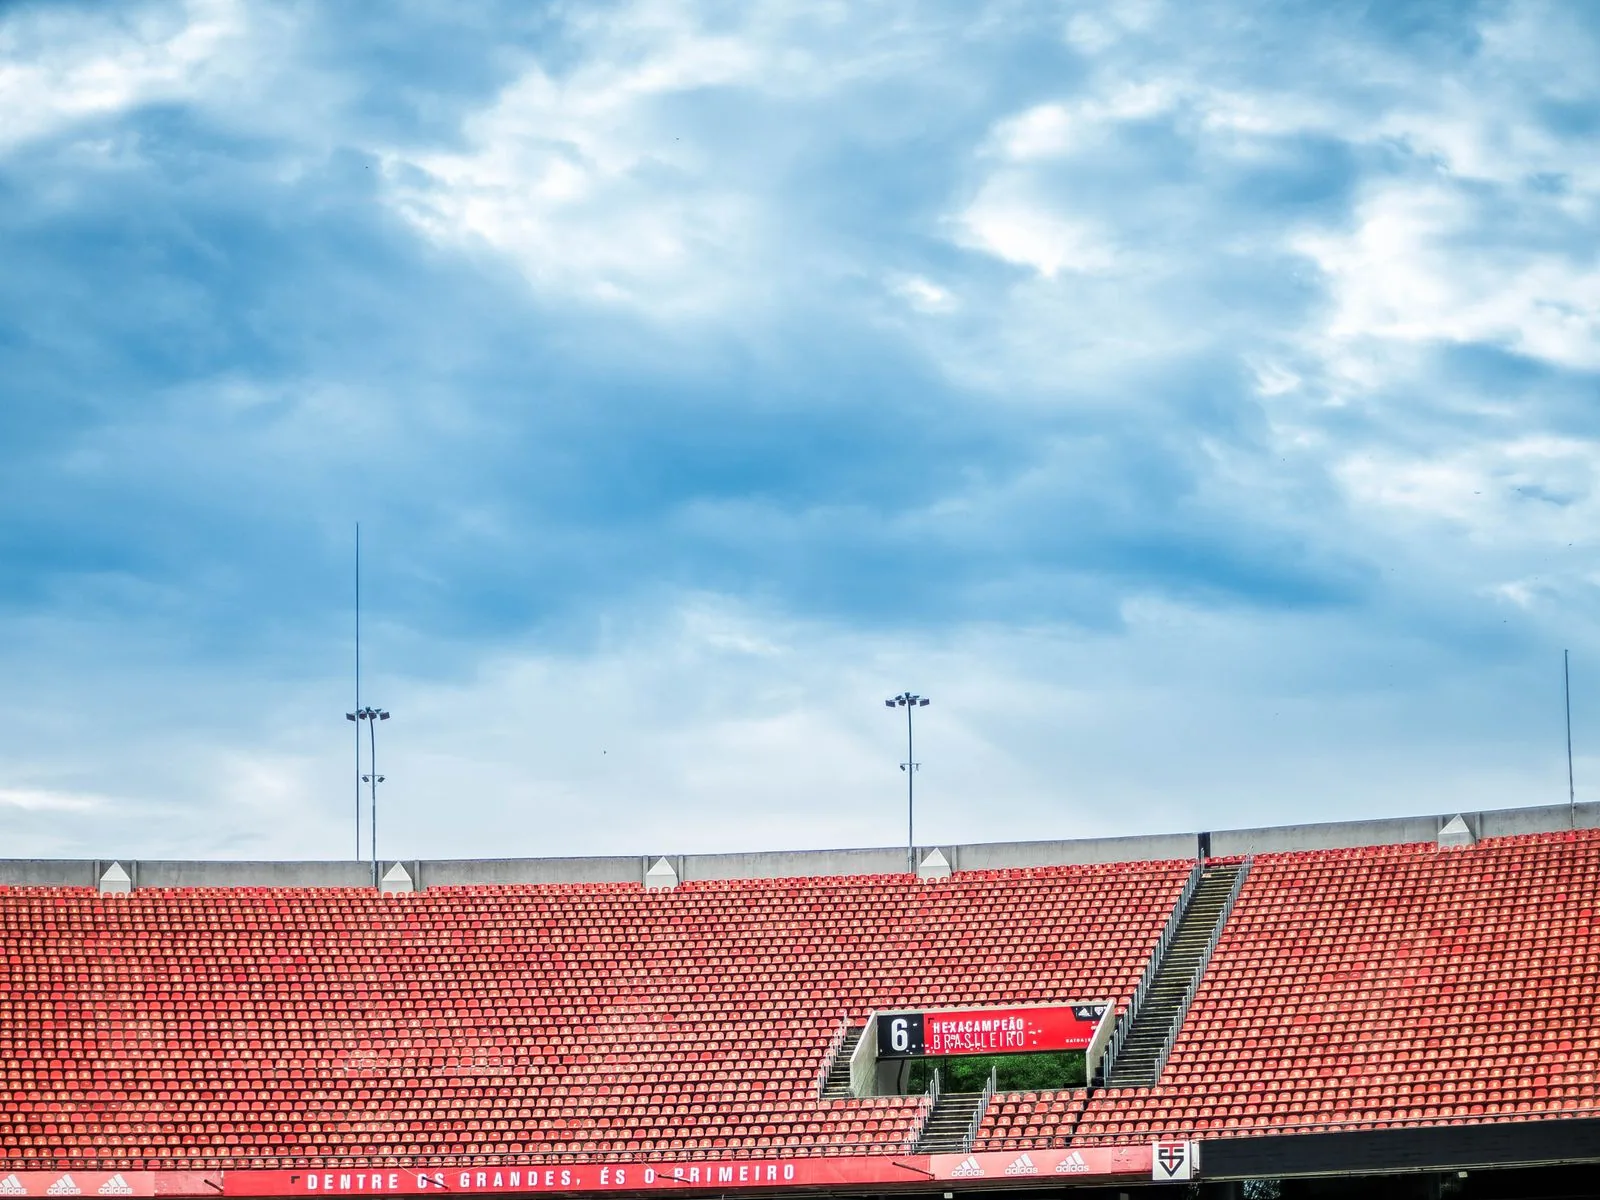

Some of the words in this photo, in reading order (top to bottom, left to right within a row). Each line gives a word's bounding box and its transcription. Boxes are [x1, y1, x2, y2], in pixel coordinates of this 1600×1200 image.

[933, 1017, 1024, 1034] HEXACAMPEÃO
[890, 1018, 909, 1051] 6
[933, 1031, 1025, 1050] BRASILEIRO
[951, 1168, 985, 1177] adidas
[1005, 1165, 1039, 1175] adidas
[1055, 1163, 1090, 1173] adidas
[307, 1173, 399, 1190] DENTRE
[417, 1172, 445, 1189] OS
[459, 1170, 581, 1188] GRANDES,
[600, 1166, 626, 1185] ÉS
[644, 1167, 655, 1184] O
[674, 1164, 795, 1183] PRIMEIRO
[0, 1187, 27, 1195] didas
[46, 1186, 81, 1195] adidas
[97, 1186, 133, 1195] adidas
